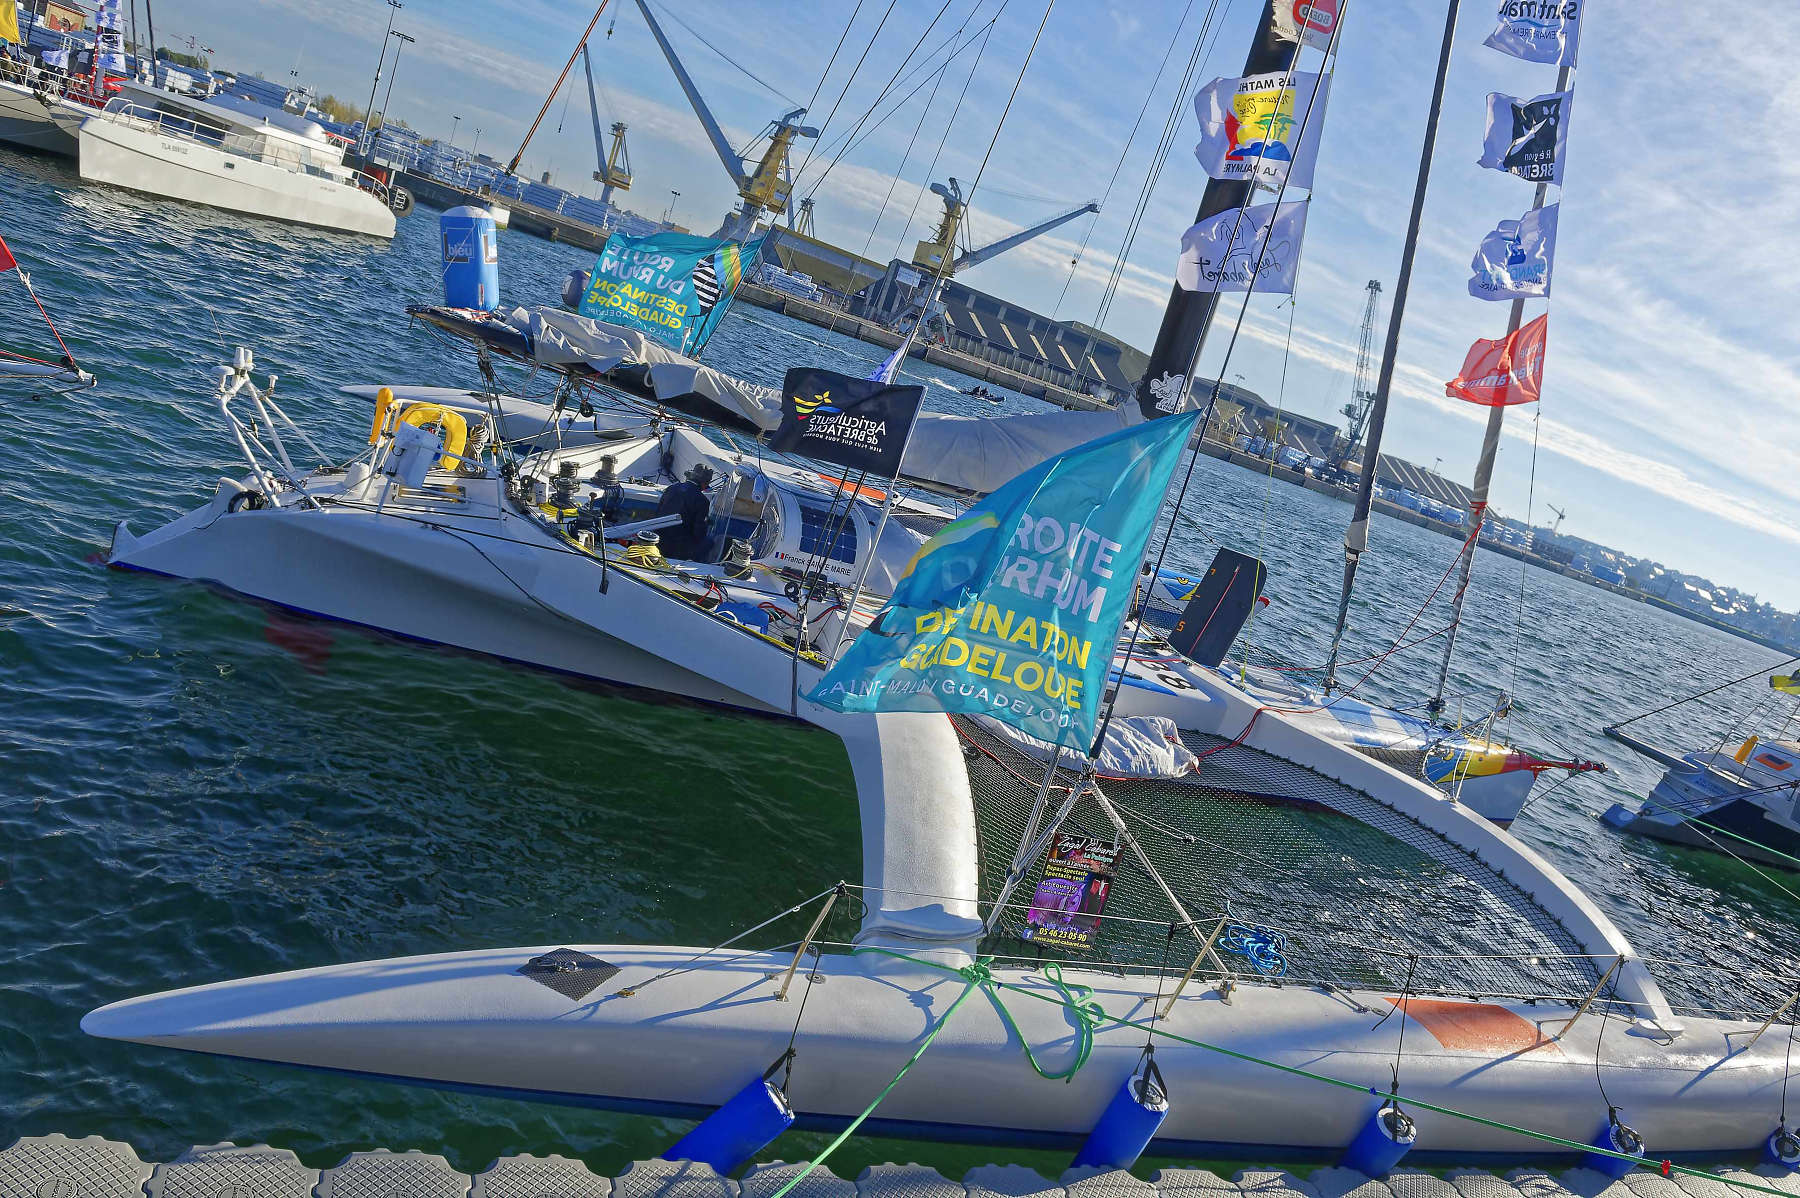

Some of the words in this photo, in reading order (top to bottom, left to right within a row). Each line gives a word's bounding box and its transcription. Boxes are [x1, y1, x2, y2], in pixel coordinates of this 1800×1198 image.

[785, 553, 805, 565] Franck
[831, 565, 852, 576] MARIE
[1039, 927, 1049, 935] 05
[1049, 929, 1058, 937] 46
[1058, 930, 1067, 939] 23
[1068, 932, 1078, 941] 05
[1078, 933, 1087, 942] 90
